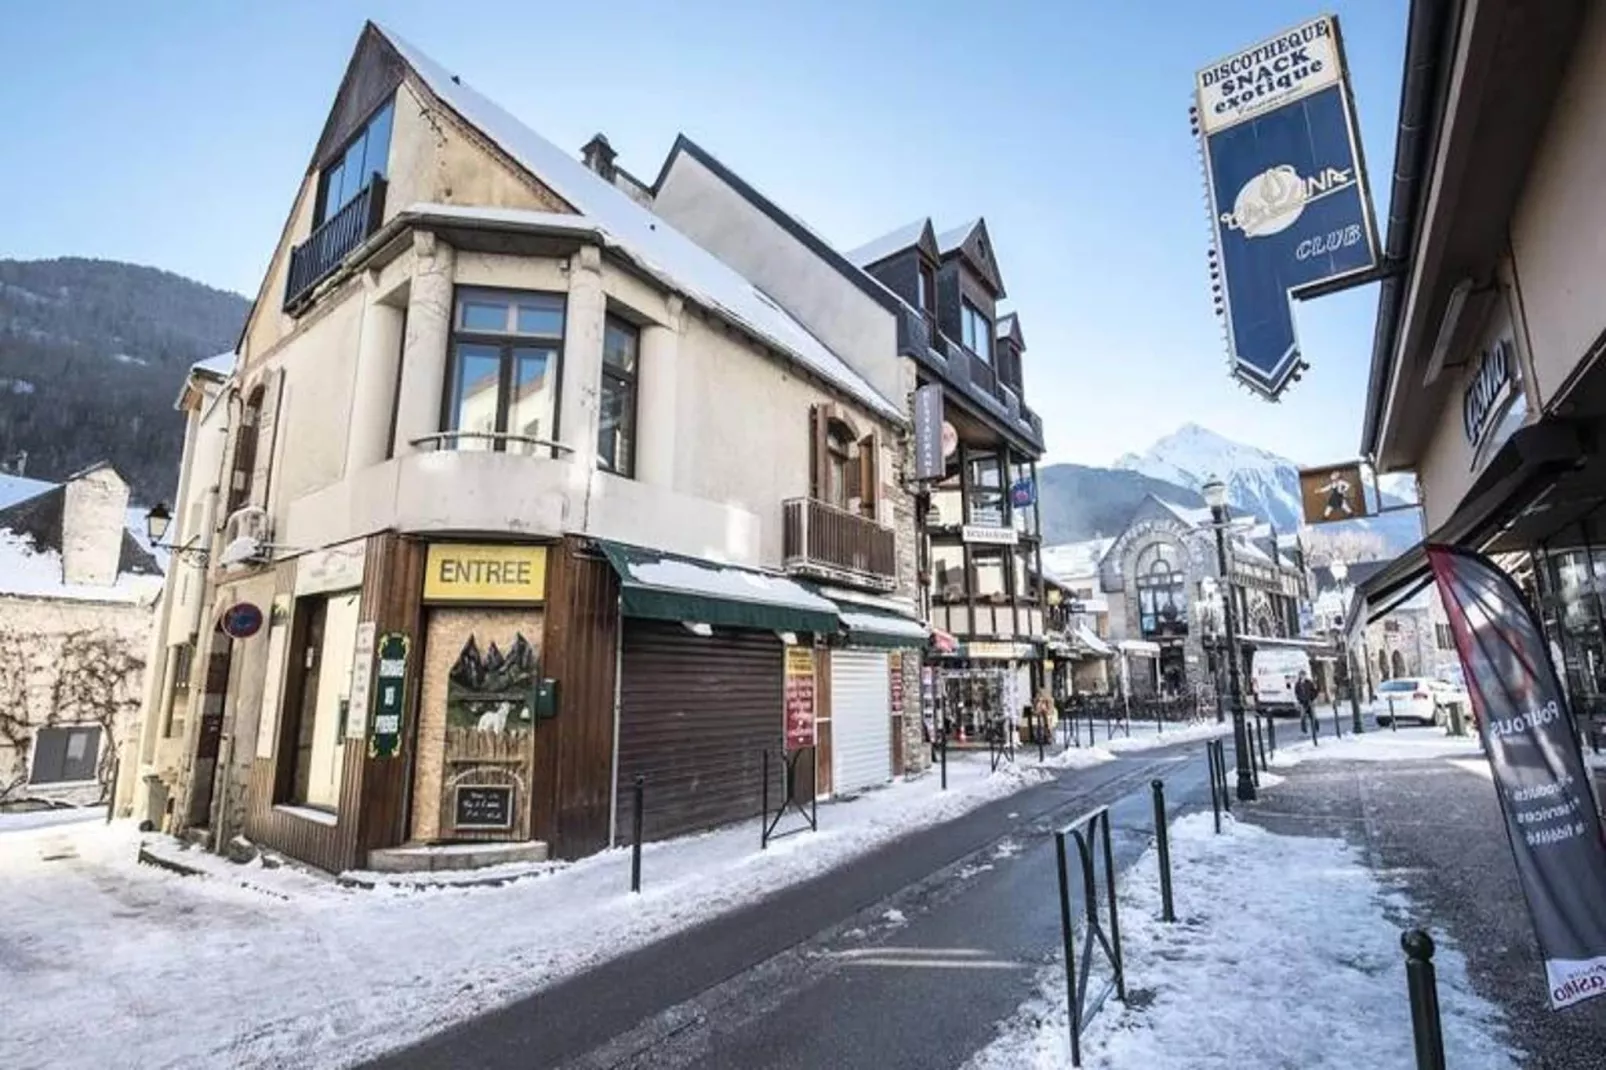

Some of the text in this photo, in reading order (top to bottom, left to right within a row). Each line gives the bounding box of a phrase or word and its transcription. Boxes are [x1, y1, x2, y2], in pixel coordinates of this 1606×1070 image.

[1201, 19, 1327, 87] DISCOTHEQUE
[1221, 47, 1310, 96] SNACK
[1213, 59, 1323, 114] exotique
[1296, 223, 1362, 260] CLUB
[440, 558, 531, 584] ENTREE
